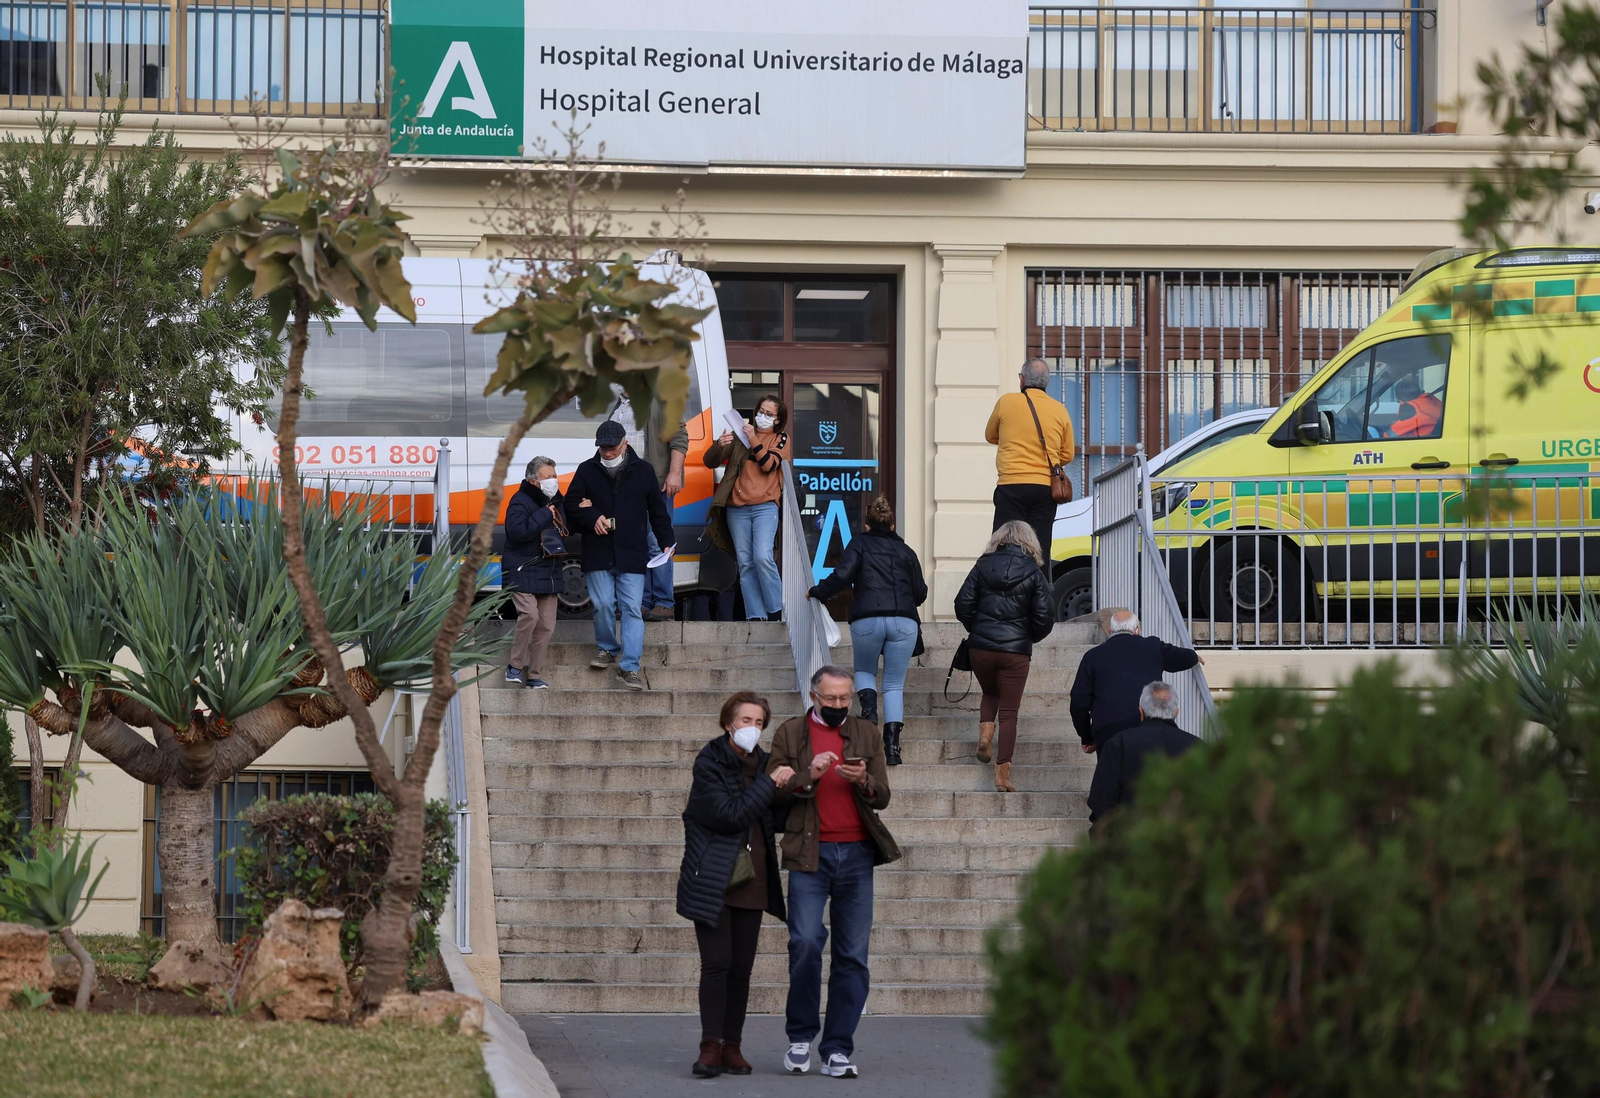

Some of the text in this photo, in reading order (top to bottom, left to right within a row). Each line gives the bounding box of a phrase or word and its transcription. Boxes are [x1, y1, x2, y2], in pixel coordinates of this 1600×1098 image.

[540, 45, 1023, 79] Hospital Regional Universitario de Málaga
[540, 89, 761, 117] Hospital General
[399, 123, 514, 137] Junta de Andalucía
[331, 445, 377, 465] 051
[389, 445, 438, 465] 880
[1353, 450, 1384, 465] ATH
[799, 471, 873, 491] Pabellón
